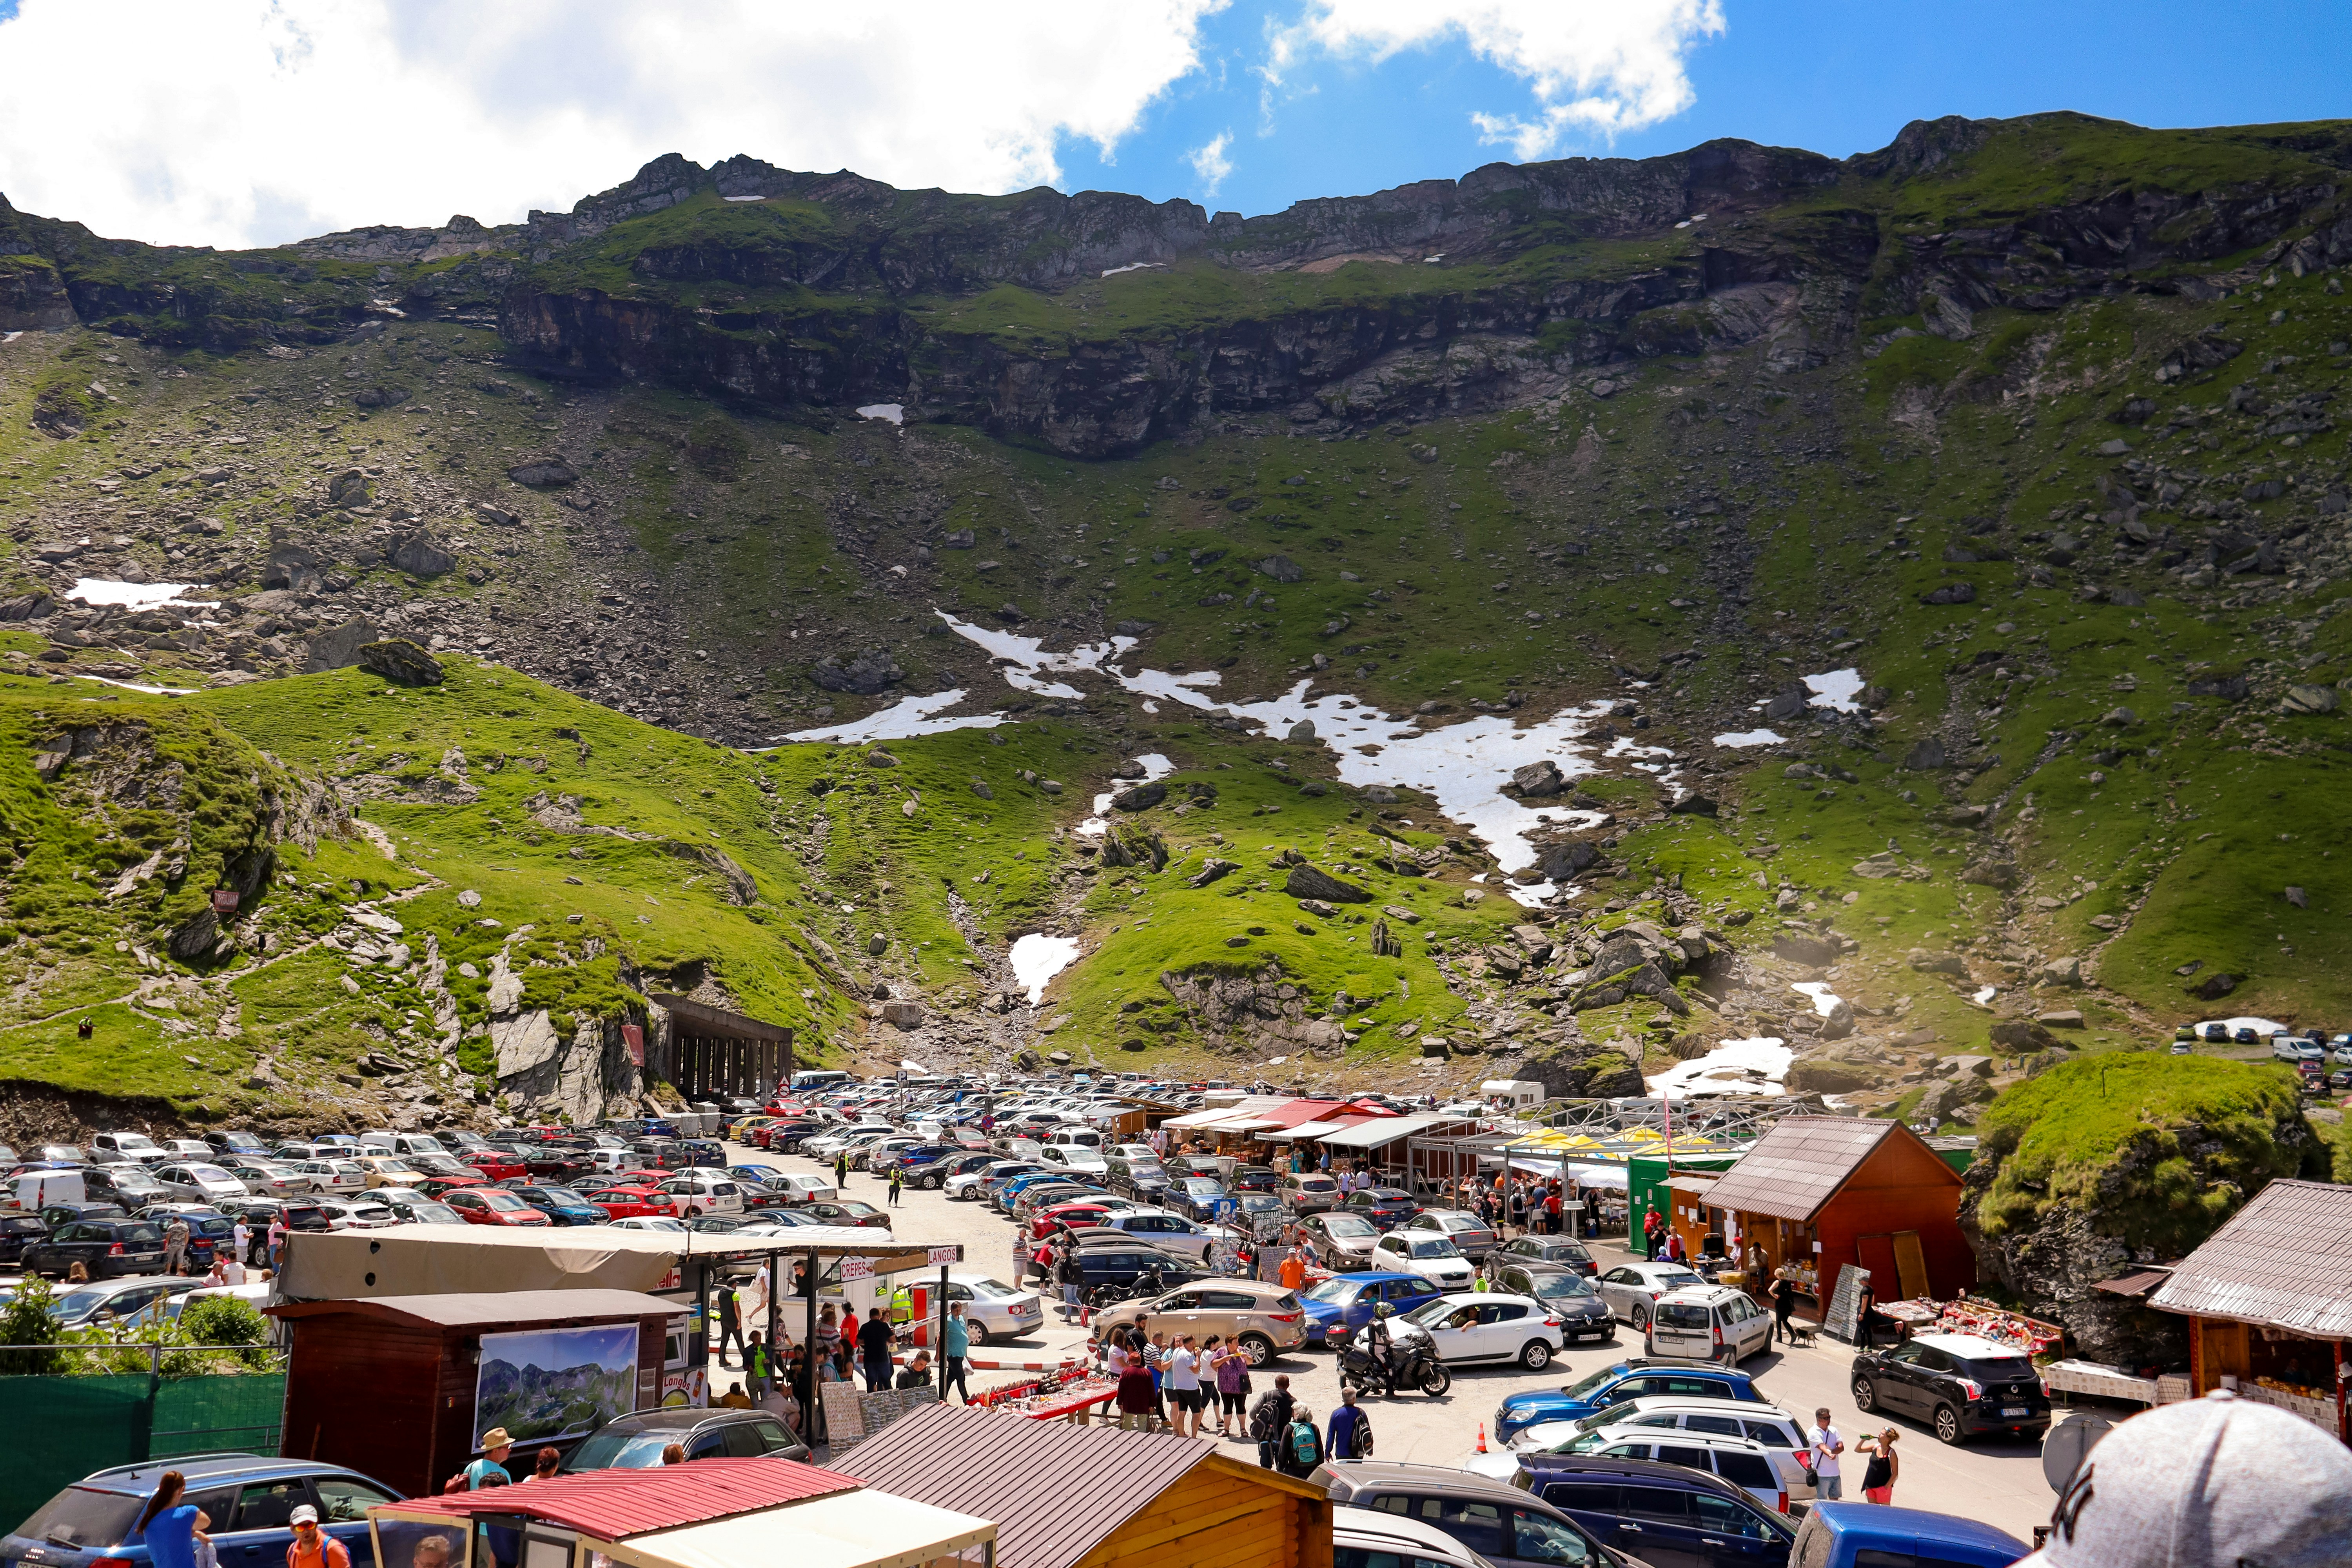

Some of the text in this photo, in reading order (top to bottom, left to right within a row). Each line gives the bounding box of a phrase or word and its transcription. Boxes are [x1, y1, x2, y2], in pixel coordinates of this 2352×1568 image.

[898, 1071, 906, 1082] P
[1220, 1201, 1230, 1215] P
[842, 1261, 866, 1278] CREPES
[664, 1377, 690, 1390] Langos
